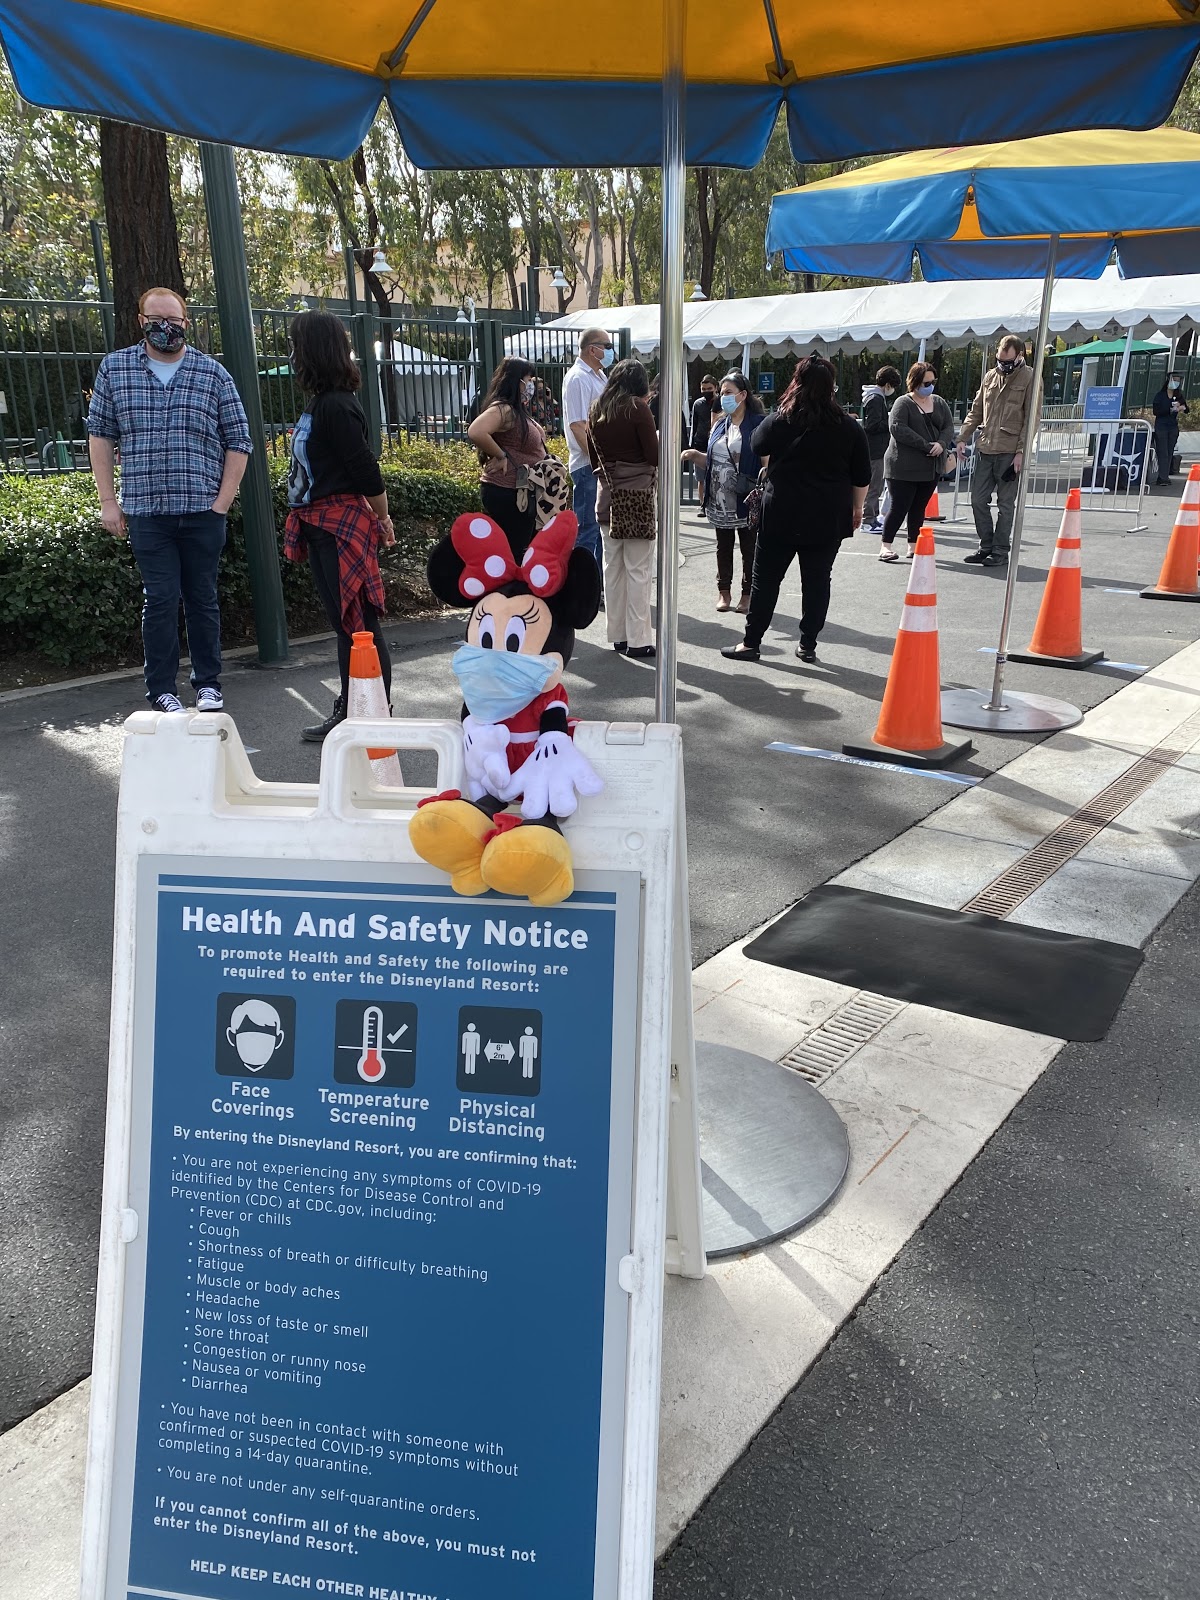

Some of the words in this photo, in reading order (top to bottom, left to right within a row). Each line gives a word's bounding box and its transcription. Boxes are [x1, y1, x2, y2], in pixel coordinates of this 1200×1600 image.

[182, 906, 282, 936] Health
[293, 911, 356, 939] And
[367, 914, 472, 950] Safety
[483, 919, 589, 950] Notice
[197, 945, 215, 958] To
[220, 948, 282, 961] promote
[288, 949, 338, 964] Health
[344, 953, 372, 965] and
[377, 953, 429, 971] Safety
[434, 956, 460, 970] the
[466, 957, 537, 976] following
[543, 964, 569, 976] are
[223, 965, 285, 980] required
[290, 968, 307, 981] to
[312, 970, 353, 983] enter
[359, 971, 384, 985] the
[390, 972, 475, 990] Disneyland
[481, 977, 539, 993] Resort:
[493, 1052, 506, 1060] 2m
[231, 1081, 270, 1098] Face
[317, 1087, 430, 1110] Temperature
[211, 1098, 295, 1121] Coverings
[329, 1107, 416, 1132] Screening
[460, 1098, 535, 1119] Physical
[448, 1116, 545, 1142] Distancing
[173, 1125, 191, 1140] By
[194, 1128, 248, 1145] entering
[251, 1131, 274, 1145] the
[278, 1133, 350, 1151] Disneyland
[354, 1139, 404, 1157] Resort,
[408, 1146, 433, 1159] you
[437, 1148, 459, 1160] are
[463, 1150, 538, 1169] confirming
[542, 1154, 577, 1170] that:
[182, 1153, 206, 1167] You
[210, 1158, 232, 1169] are
[236, 1159, 258, 1172] not
[262, 1163, 348, 1182] experiencing
[353, 1170, 377, 1185] any
[382, 1173, 452, 1189] symptoms
[457, 1177, 472, 1190] of
[476, 1178, 541, 1196] COVID-19
[171, 1169, 232, 1186] identified
[237, 1175, 253, 1191] by
[257, 1176, 279, 1191] the
[283, 1179, 335, 1196] Centers
[340, 1184, 360, 1198] for
[364, 1186, 417, 1203] Disease
[422, 1191, 473, 1208] Control
[478, 1198, 504, 1211] and
[171, 1186, 241, 1204] Prevention
[245, 1193, 283, 1209] (CDC)
[287, 1197, 301, 1210] at
[305, 1198, 365, 1217] CDC.gov,
[370, 1204, 436, 1225] including:
[199, 1205, 235, 1220] Fever
[239, 1211, 253, 1222] or
[258, 1211, 292, 1226] chills
[198, 1222, 240, 1240] Cough
[197, 1256, 244, 1273] Fatigue
[198, 1239, 264, 1258] Shortness
[268, 1246, 282, 1259] of
[286, 1247, 330, 1264] breath
[335, 1255, 350, 1266] or
[354, 1255, 416, 1276] difficulty
[421, 1261, 488, 1283] breathing
[195, 1289, 260, 1309] Headache
[196, 1272, 241, 1289] Muscle
[245, 1280, 260, 1291] or
[264, 1280, 297, 1298] body
[301, 1285, 340, 1300] aches
[194, 1324, 224, 1339] Sore
[228, 1328, 269, 1344] throat
[195, 1307, 223, 1321] New
[227, 1310, 252, 1325] loss
[257, 1314, 271, 1327] of
[275, 1315, 309, 1331] taste
[313, 1322, 329, 1333] or
[333, 1324, 368, 1338] smell
[193, 1341, 266, 1361] Congestion
[271, 1352, 286, 1363] or
[291, 1355, 330, 1371] runny
[334, 1360, 366, 1373] nose
[191, 1375, 248, 1394] Diarrhea
[192, 1358, 240, 1376] Nausea
[245, 1367, 259, 1378] or
[264, 1369, 322, 1388] vomiting
[170, 1401, 194, 1417] You
[199, 1405, 230, 1421] have
[234, 1411, 256, 1425] not
[261, 1413, 293, 1429] been
[298, 1417, 310, 1431] in
[315, 1422, 366, 1439] contact
[372, 1428, 400, 1443] with
[405, 1434, 469, 1452] someone
[474, 1441, 504, 1456] with
[158, 1437, 230, 1459] completing
[235, 1447, 242, 1458] a
[247, 1447, 290, 1467] 14-day
[294, 1455, 372, 1475] quarantine.
[159, 1420, 225, 1438] confirmed
[229, 1429, 244, 1440] or
[248, 1431, 316, 1450] suspected
[321, 1438, 384, 1458] COVID-19
[388, 1450, 459, 1469] symptoms
[465, 1458, 519, 1477] without
[167, 1465, 191, 1480] You
[195, 1471, 217, 1484] are
[221, 1474, 243, 1488] not
[248, 1479, 287, 1493] under
[291, 1485, 316, 1500] any
[320, 1488, 425, 1513] self-quarantine
[430, 1504, 480, 1521] orders.
[153, 1515, 190, 1530] enter
[194, 1519, 218, 1534] the
[223, 1523, 300, 1546] Disneyland
[305, 1535, 358, 1555] Resort.
[155, 1495, 166, 1509] If
[170, 1500, 194, 1513] you
[199, 1504, 247, 1520] cannot
[252, 1512, 306, 1529] confirm
[311, 1519, 329, 1532] all
[334, 1522, 349, 1535] of
[353, 1524, 377, 1539] the
[382, 1529, 429, 1549] above,
[435, 1538, 461, 1552] you
[467, 1543, 506, 1558] must
[511, 1549, 537, 1563] not
[190, 1558, 227, 1575] HELP
[230, 1565, 268, 1582] KEEP
[272, 1571, 311, 1589] EACH
[315, 1578, 364, 1598] OTHER
